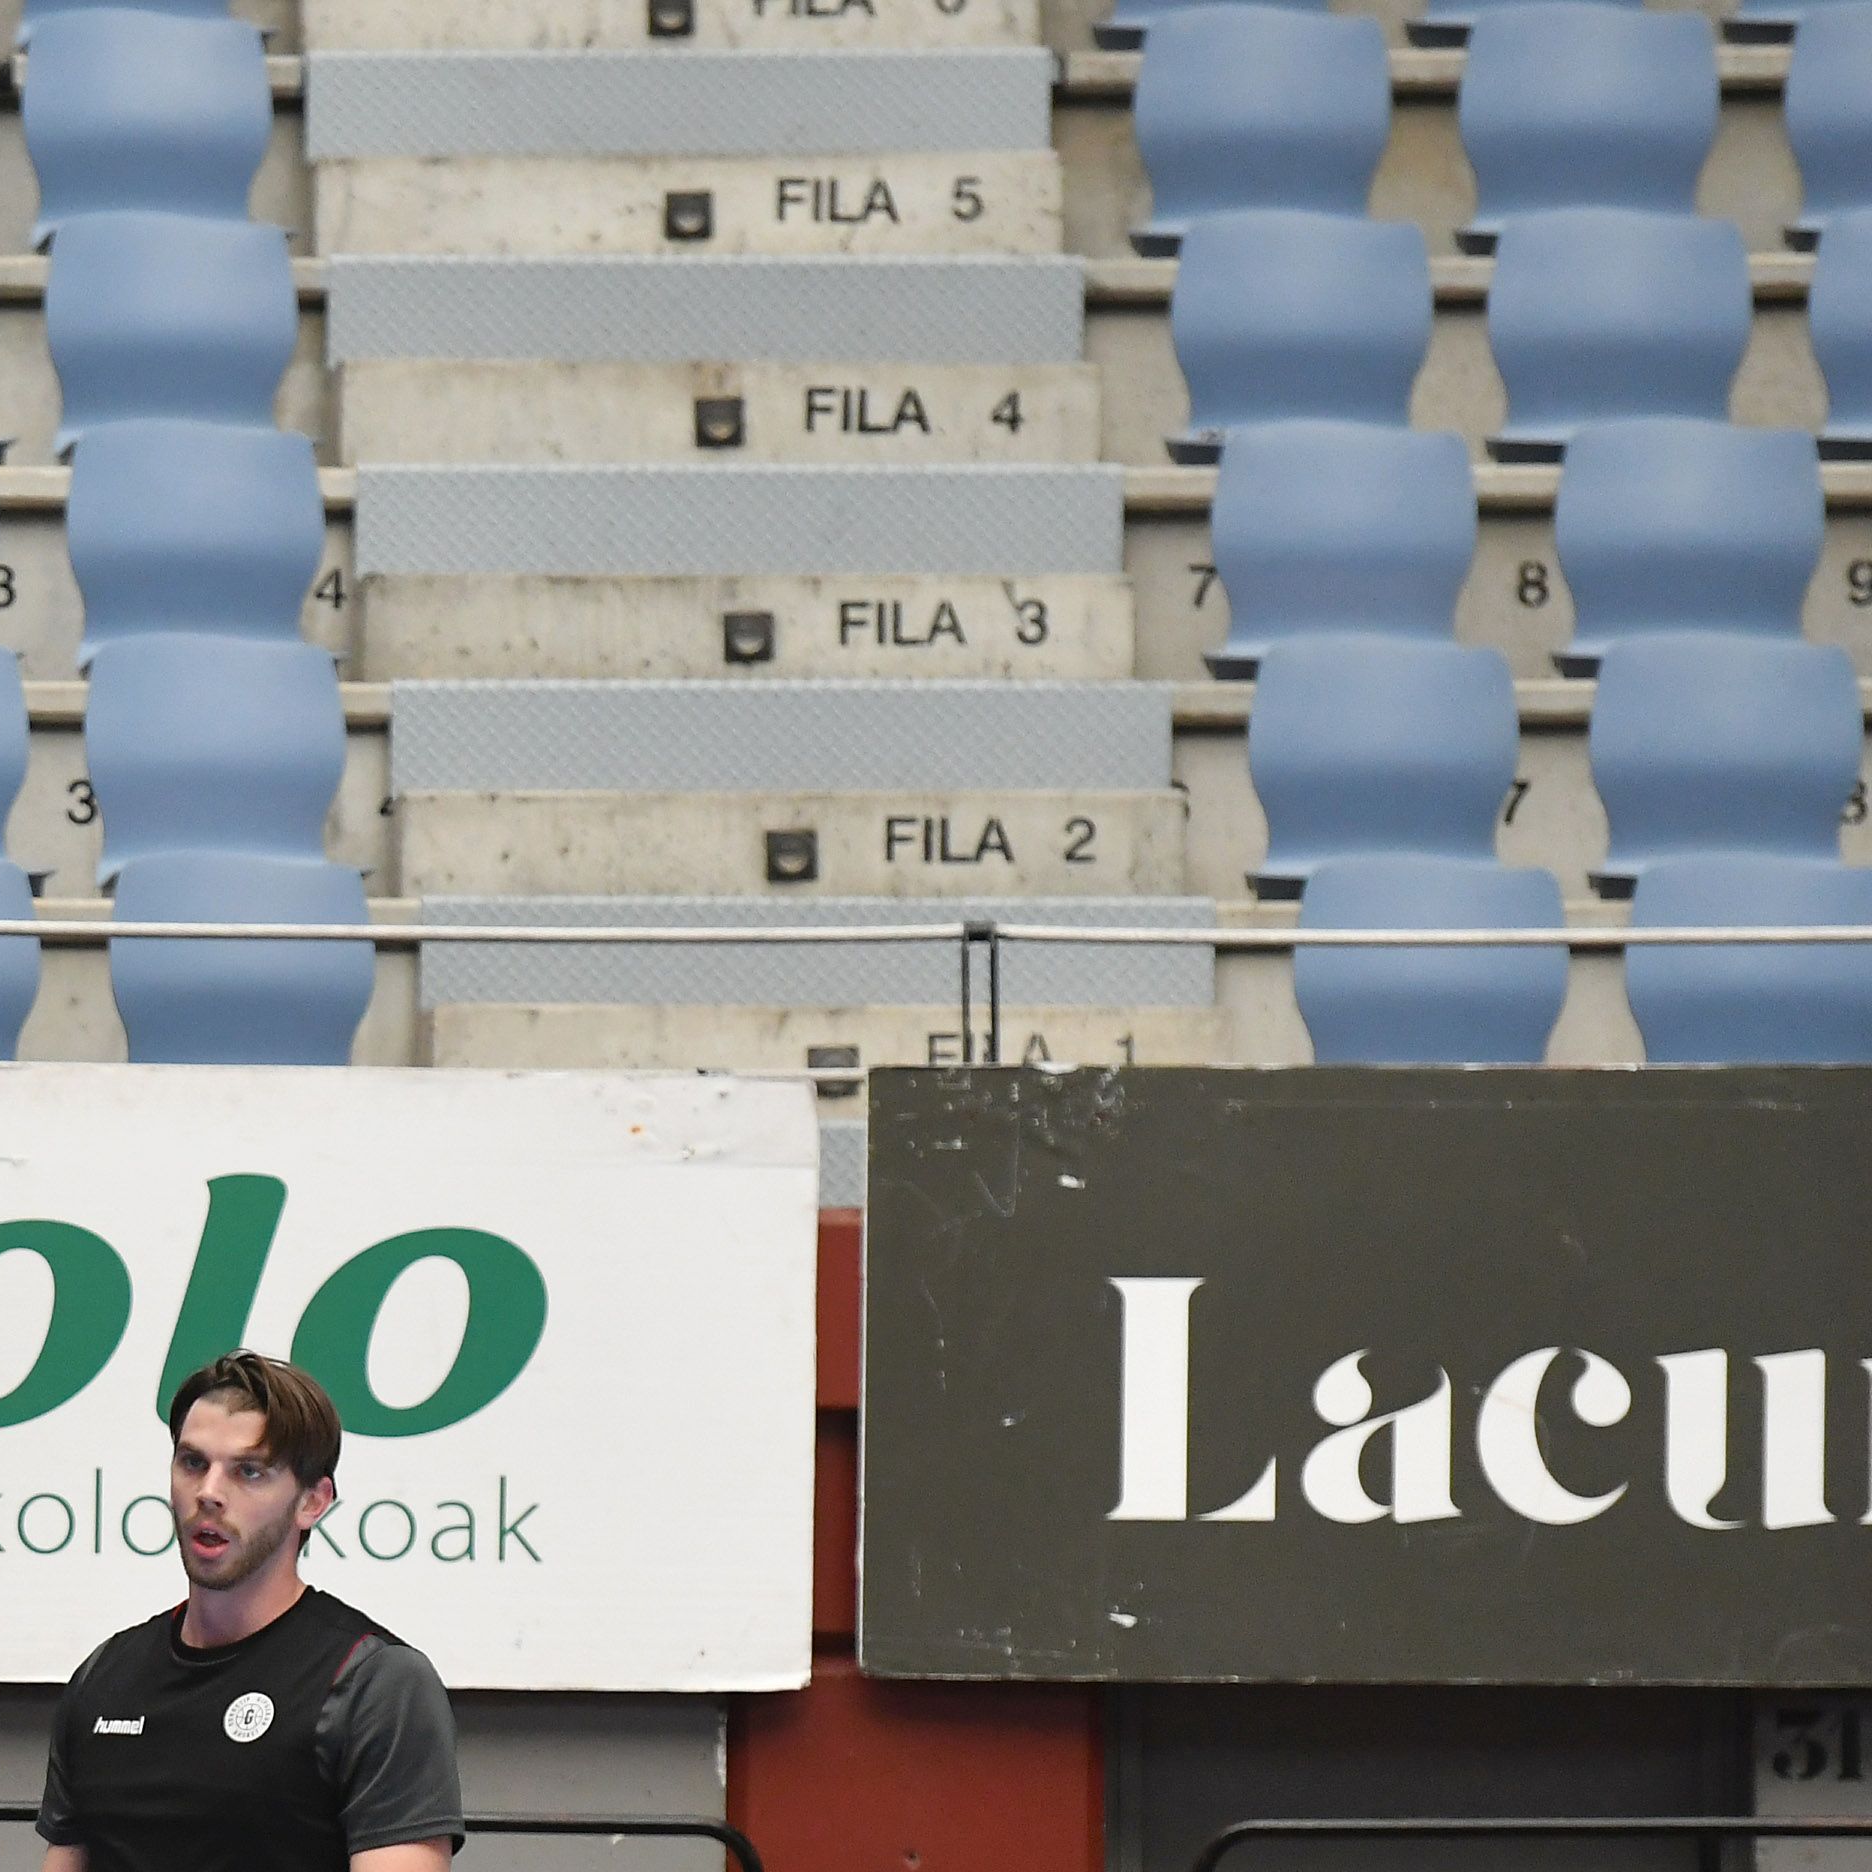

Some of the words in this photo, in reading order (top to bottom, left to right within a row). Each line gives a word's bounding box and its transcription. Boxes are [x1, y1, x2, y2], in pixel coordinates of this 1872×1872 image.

[777, 176, 899, 225] FILA
[951, 175, 984, 222] 5
[806, 387, 932, 434] FILA
[990, 390, 1024, 433] 4
[314, 565, 348, 610] 4
[1187, 563, 1218, 608] 7
[1517, 560, 1549, 608] 8
[1846, 560, 1872, 606] 9
[839, 601, 968, 647] FILA
[1015, 599, 1050, 646] 3
[65, 780, 98, 824] 3
[884, 816, 1015, 865] FILA
[1063, 817, 1097, 863] 2
[1106, 1276, 1872, 1531] Lacu
[92, 1714, 146, 1736] hummel
